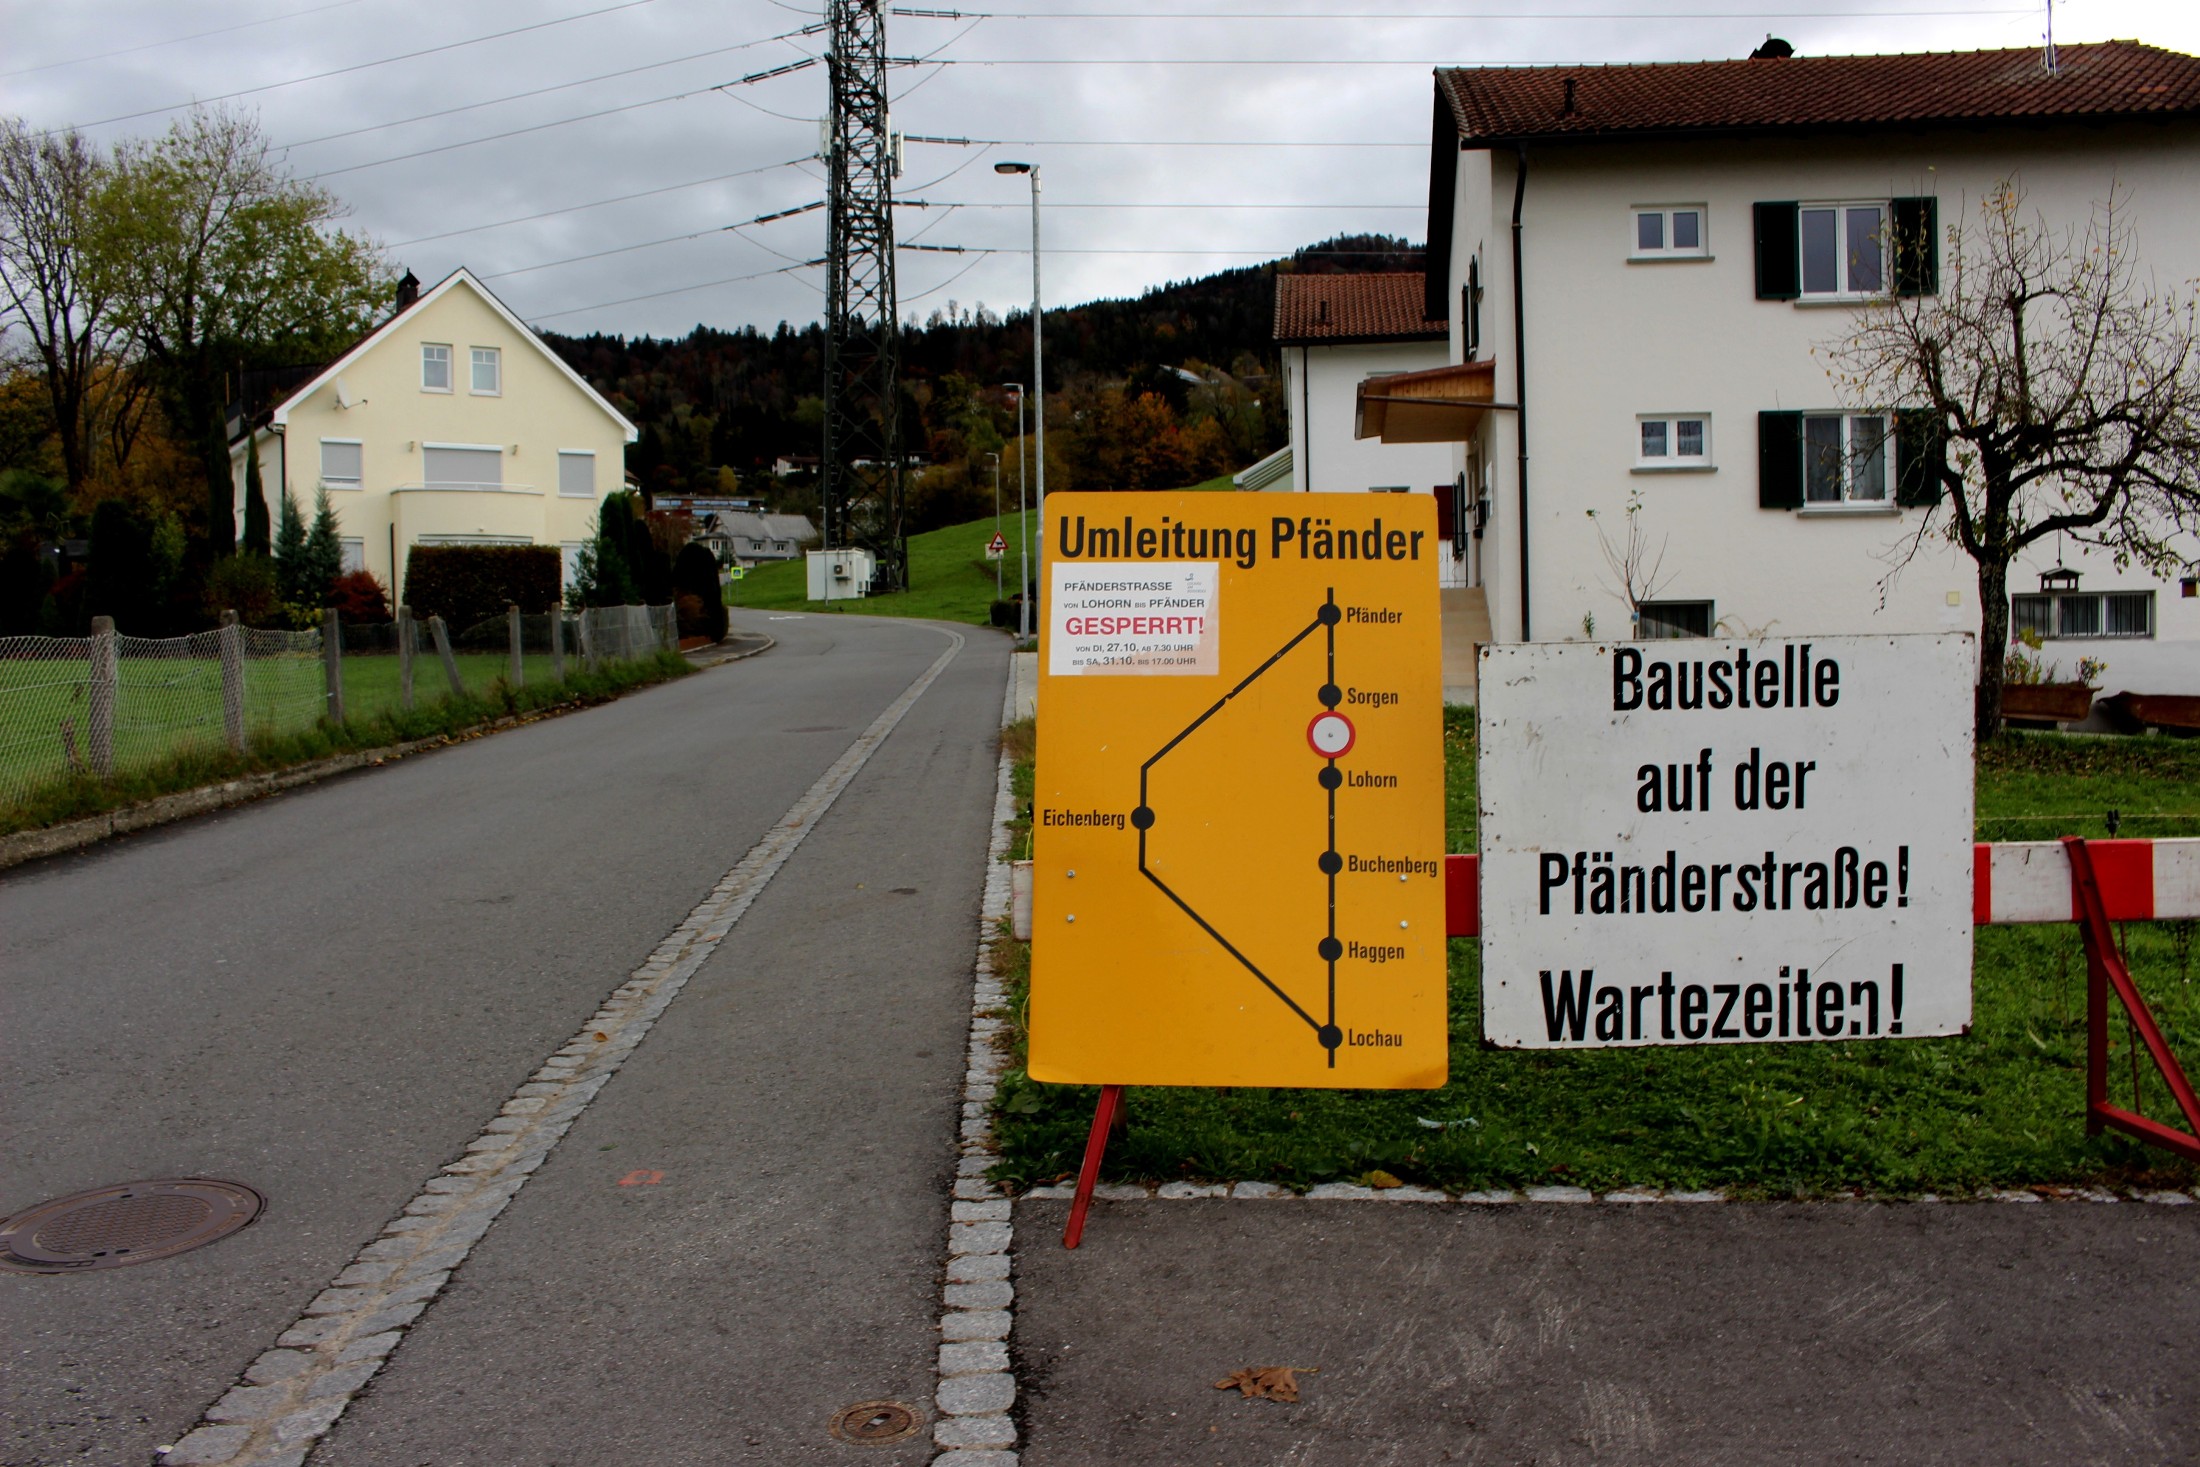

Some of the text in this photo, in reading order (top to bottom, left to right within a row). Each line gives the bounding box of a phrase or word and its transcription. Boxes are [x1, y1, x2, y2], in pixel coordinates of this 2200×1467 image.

[1059, 516, 1424, 569] Umleitung Pfänder
[1064, 580, 1172, 592] PFÄNDERSTRASSE
[1082, 600, 1131, 608] LOHORN
[1149, 597, 1204, 608] PFÄNDER
[1346, 607, 1402, 624] Pfänder
[1066, 617, 1204, 635] GESPERRT!
[1093, 645, 1104, 653] DI,
[1107, 643, 1139, 652] 27.10.
[1086, 658, 1100, 666] SA,
[1103, 657, 1135, 665] 31.10.
[1613, 643, 1840, 711] Baustelle
[1347, 688, 1398, 708] Sorgen
[1348, 770, 1397, 788] Lohorn
[1637, 747, 1816, 813] auf der
[1043, 809, 1125, 831] Eichenberg
[1349, 855, 1438, 877] Buchenberg
[1539, 845, 1910, 915] Pfänderstraße!
[1349, 941, 1405, 963] Haggen
[1539, 963, 1905, 1042] Wartezeiten!
[1349, 1029, 1402, 1047] Lochau
